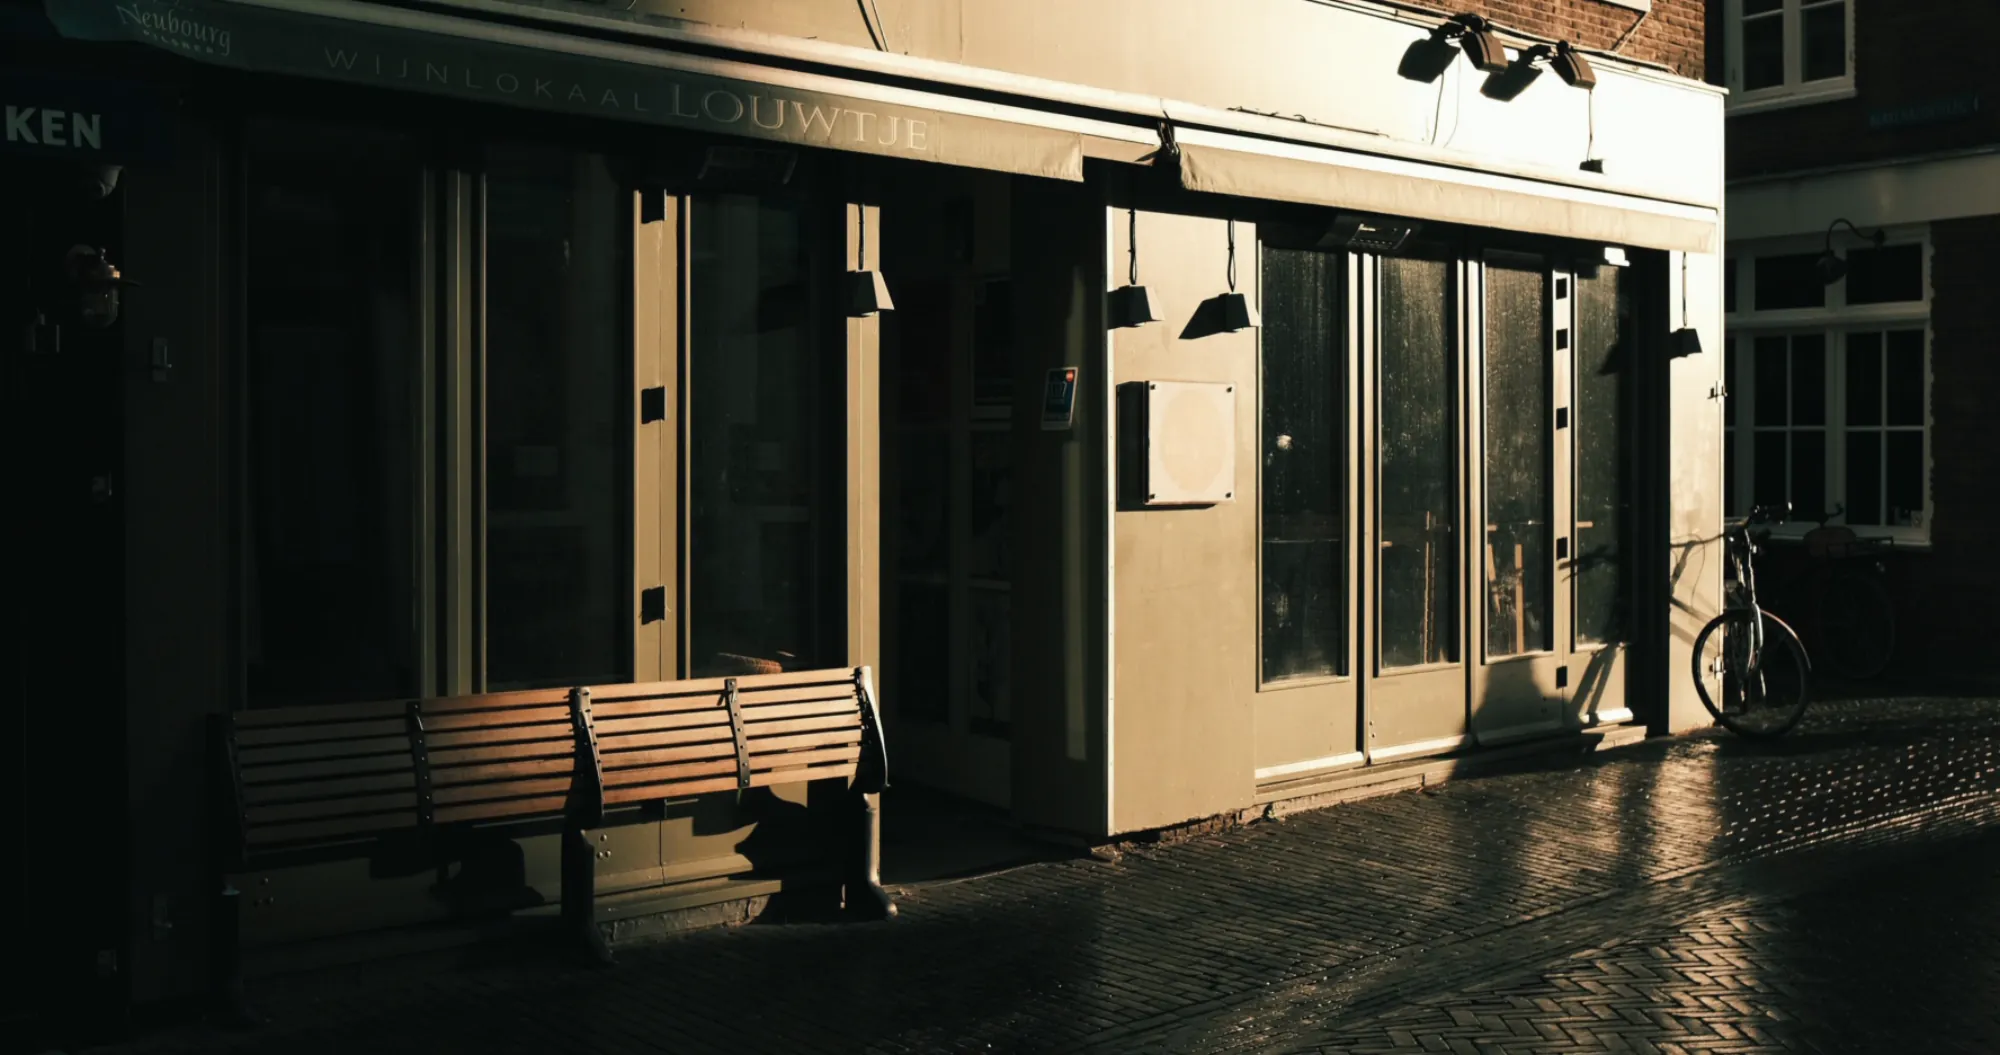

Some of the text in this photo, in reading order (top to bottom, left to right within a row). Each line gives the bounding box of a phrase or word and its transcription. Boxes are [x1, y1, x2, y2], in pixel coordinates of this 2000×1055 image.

[115, 4, 231, 56] Neubourg
[324, 46, 928, 151] WIJNLOKAAL LOUWTJE
[4, 104, 103, 150] KEN
